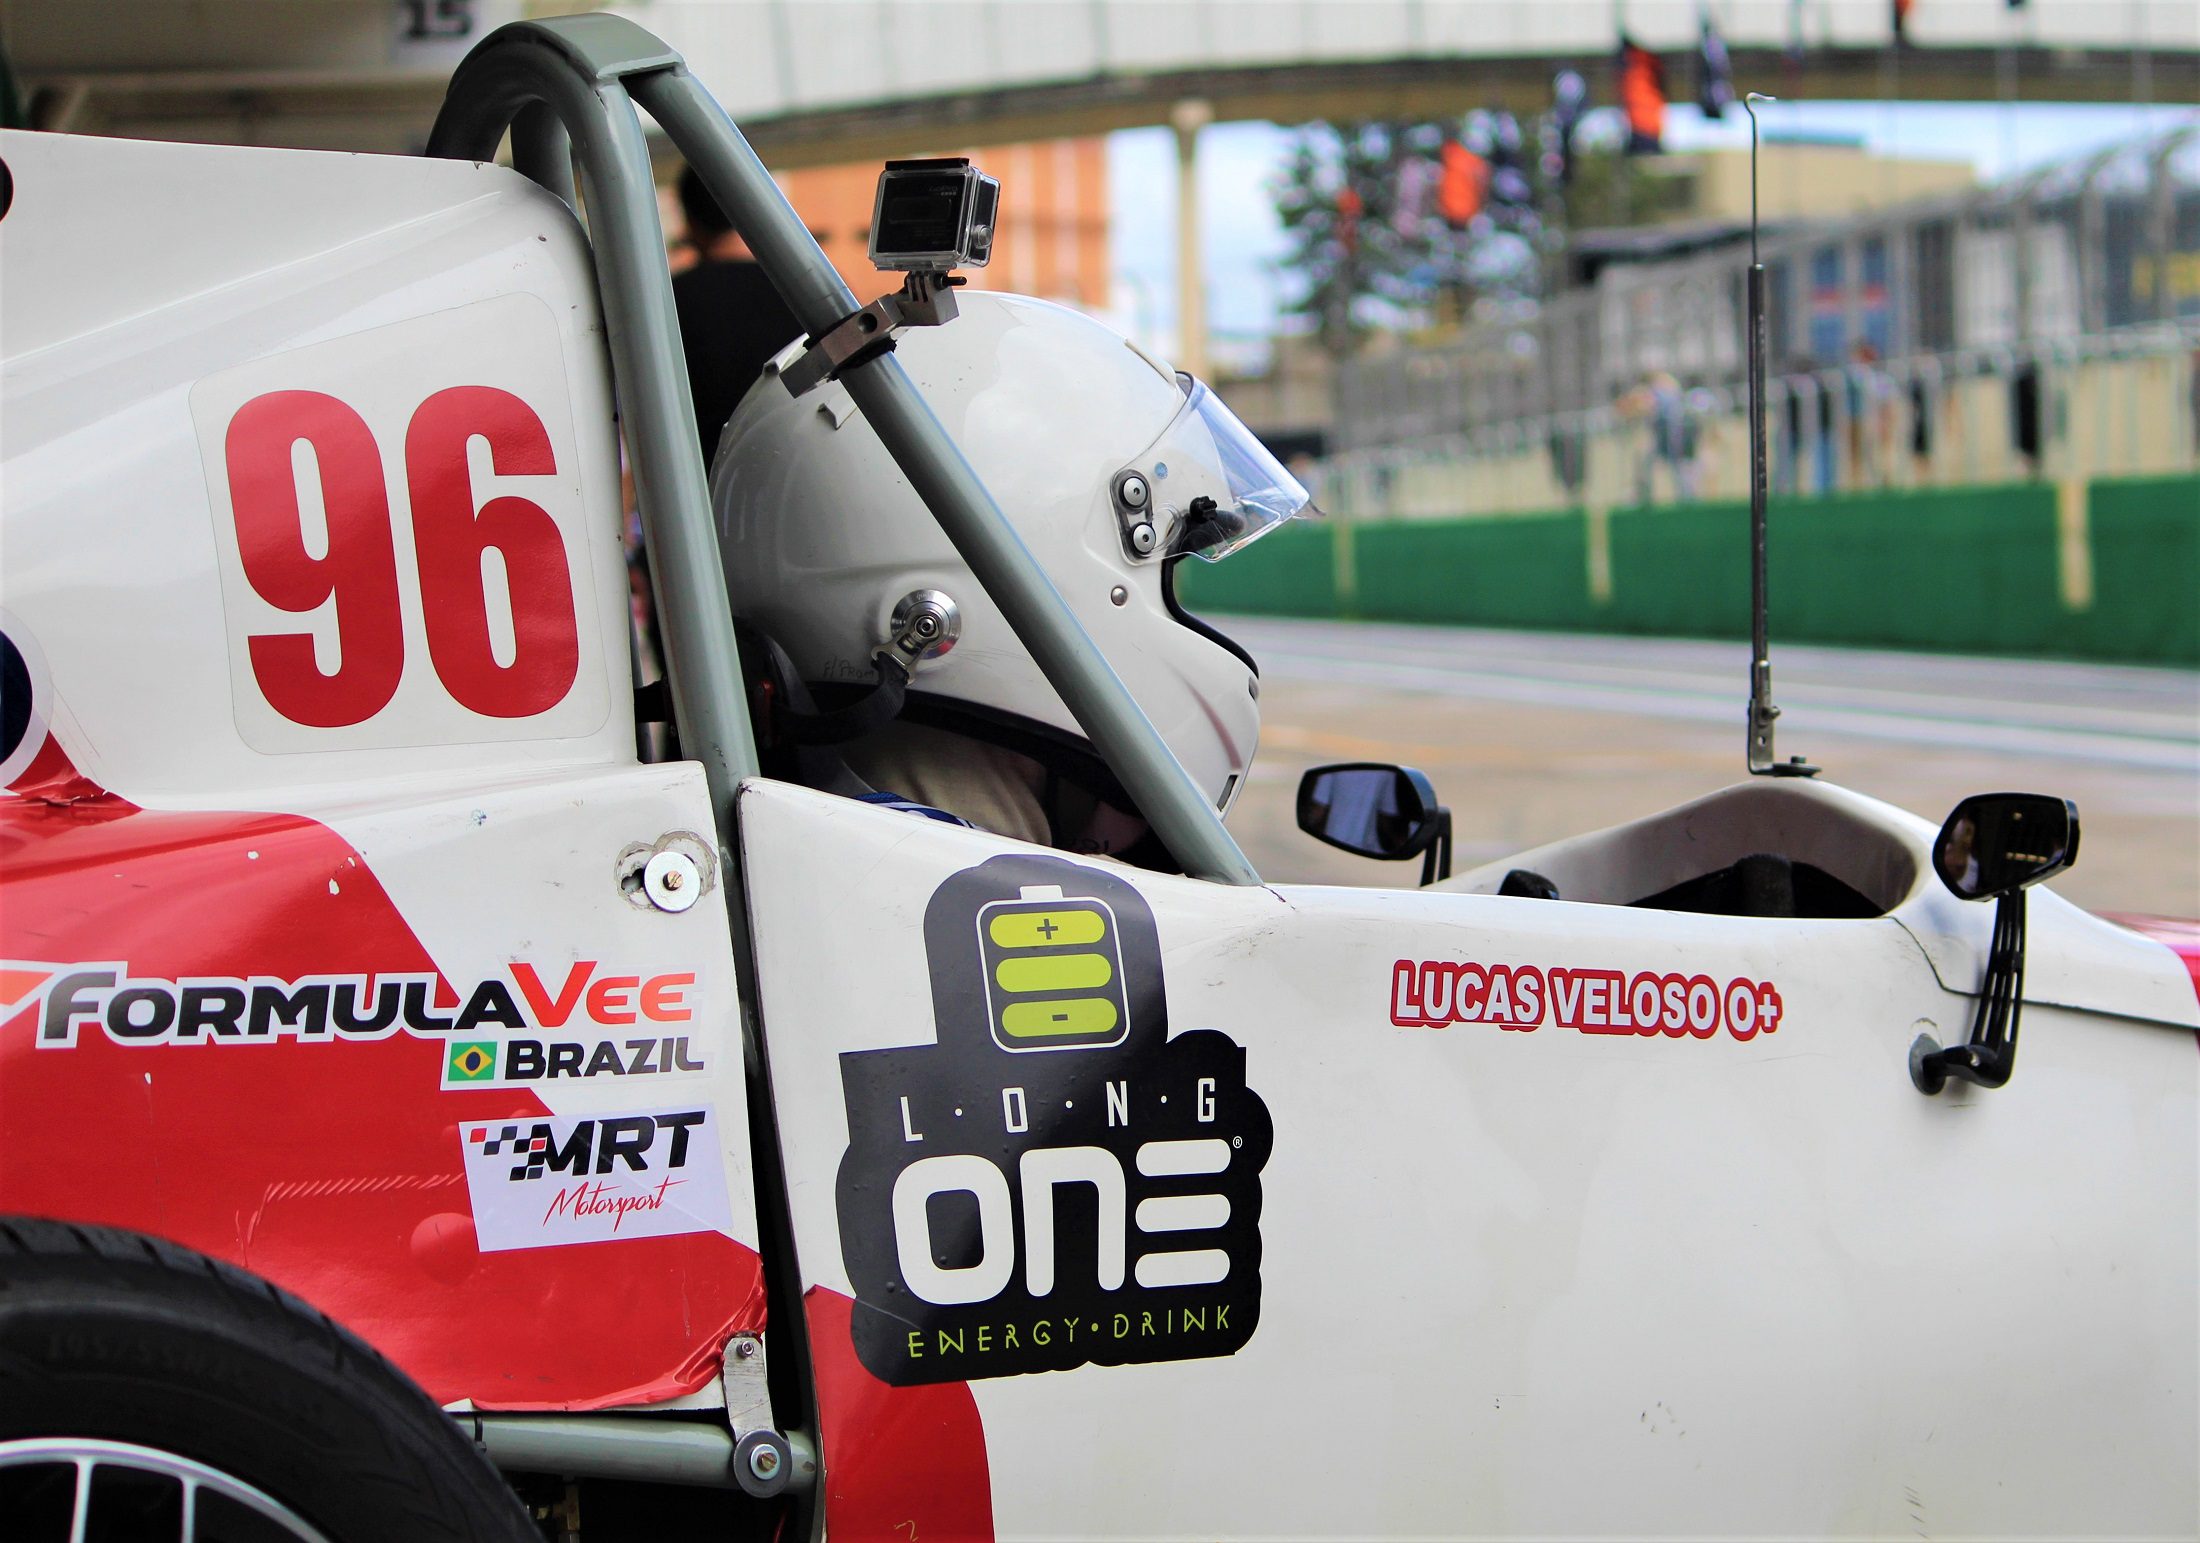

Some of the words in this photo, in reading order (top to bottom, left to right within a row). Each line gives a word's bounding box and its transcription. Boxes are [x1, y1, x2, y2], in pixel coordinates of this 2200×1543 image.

[225, 385, 579, 728] 96
[1396, 969, 1542, 1023] LUCAS
[1554, 975, 1716, 1031] VELOSO
[505, 1037, 705, 1080] BRAZIL
[526, 1111, 706, 1177] MRT
[543, 1174, 689, 1232] Motorsport
